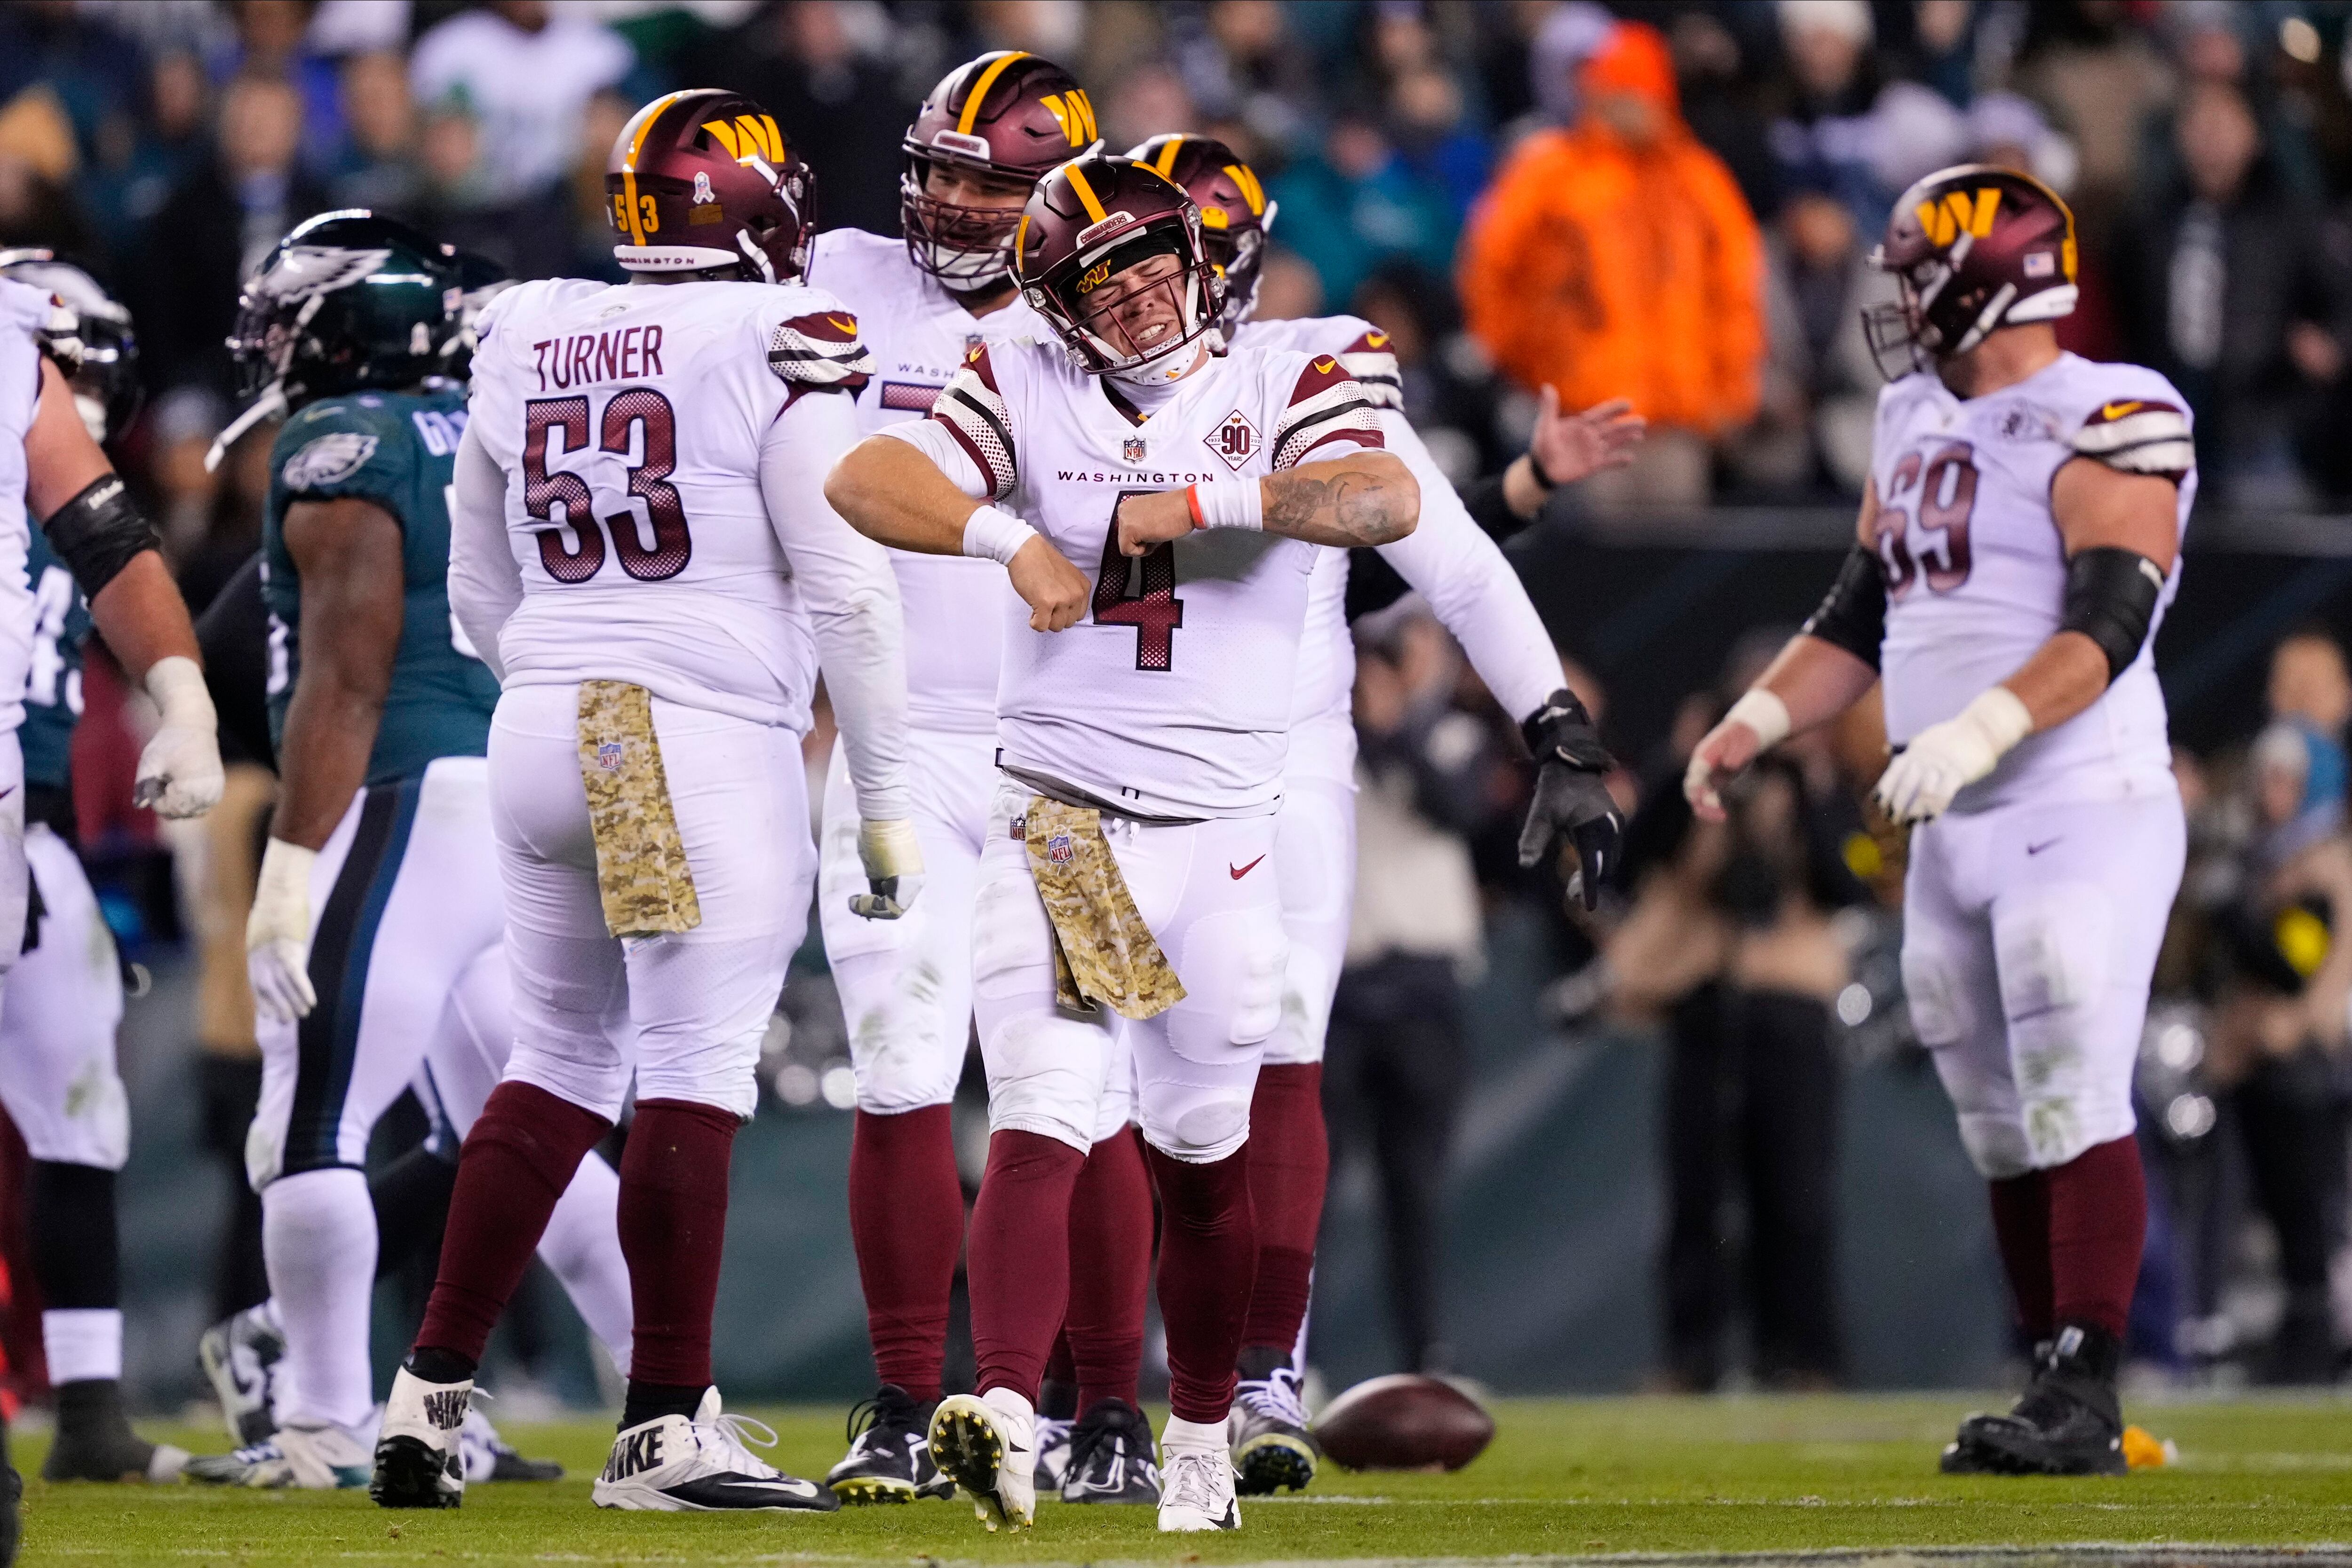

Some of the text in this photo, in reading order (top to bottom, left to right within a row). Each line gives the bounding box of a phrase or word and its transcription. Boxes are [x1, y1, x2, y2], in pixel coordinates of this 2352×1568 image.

[614, 194, 659, 232] 53
[1081, 215, 1127, 244] COMMANDERS
[533, 325, 663, 391] TURNER
[898, 363, 954, 378] WASH
[1127, 448, 1143, 458] NFL
[1222, 425, 1250, 455] 90
[523, 388, 691, 583] 53
[1058, 471, 1214, 483] WASHINGTON
[1875, 440, 1980, 606] 69
[1091, 491, 1184, 671] 4
[602, 754, 620, 766] NFL
[1051, 847, 1070, 861] NFL
[424, 1389, 471, 1430] NIKE
[602, 1425, 664, 1483] NIKE
